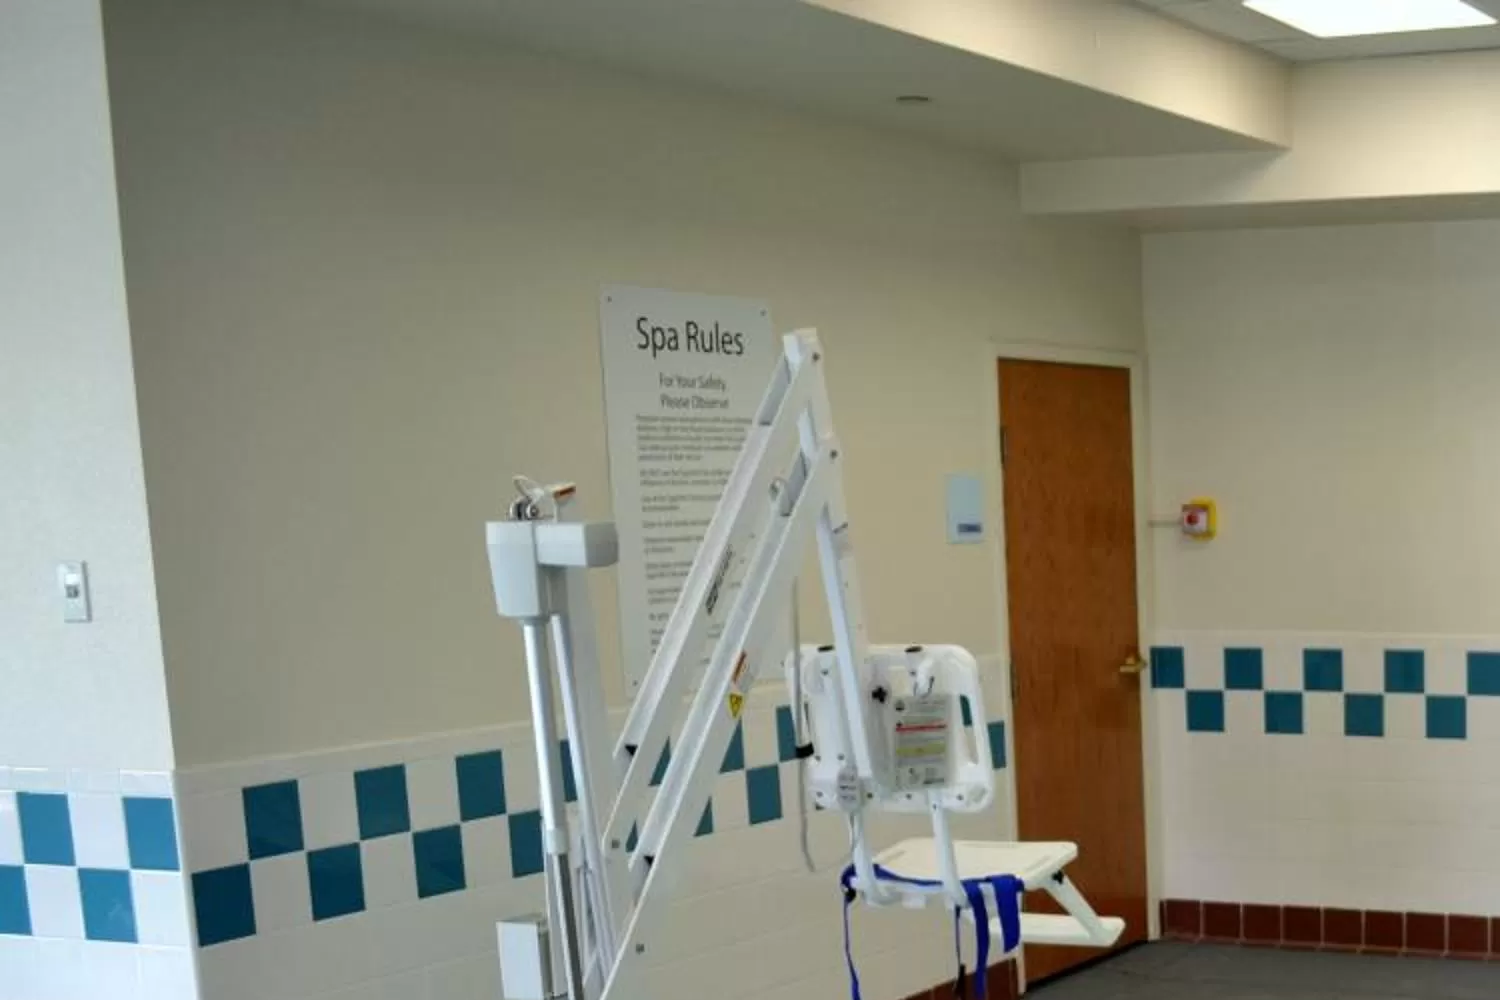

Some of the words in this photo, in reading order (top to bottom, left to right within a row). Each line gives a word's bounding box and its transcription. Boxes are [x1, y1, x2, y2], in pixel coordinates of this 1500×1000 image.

[636, 316, 679, 359] Spa
[685, 320, 744, 356] Rules
[659, 371, 673, 388] For
[676, 373, 697, 389] Your
